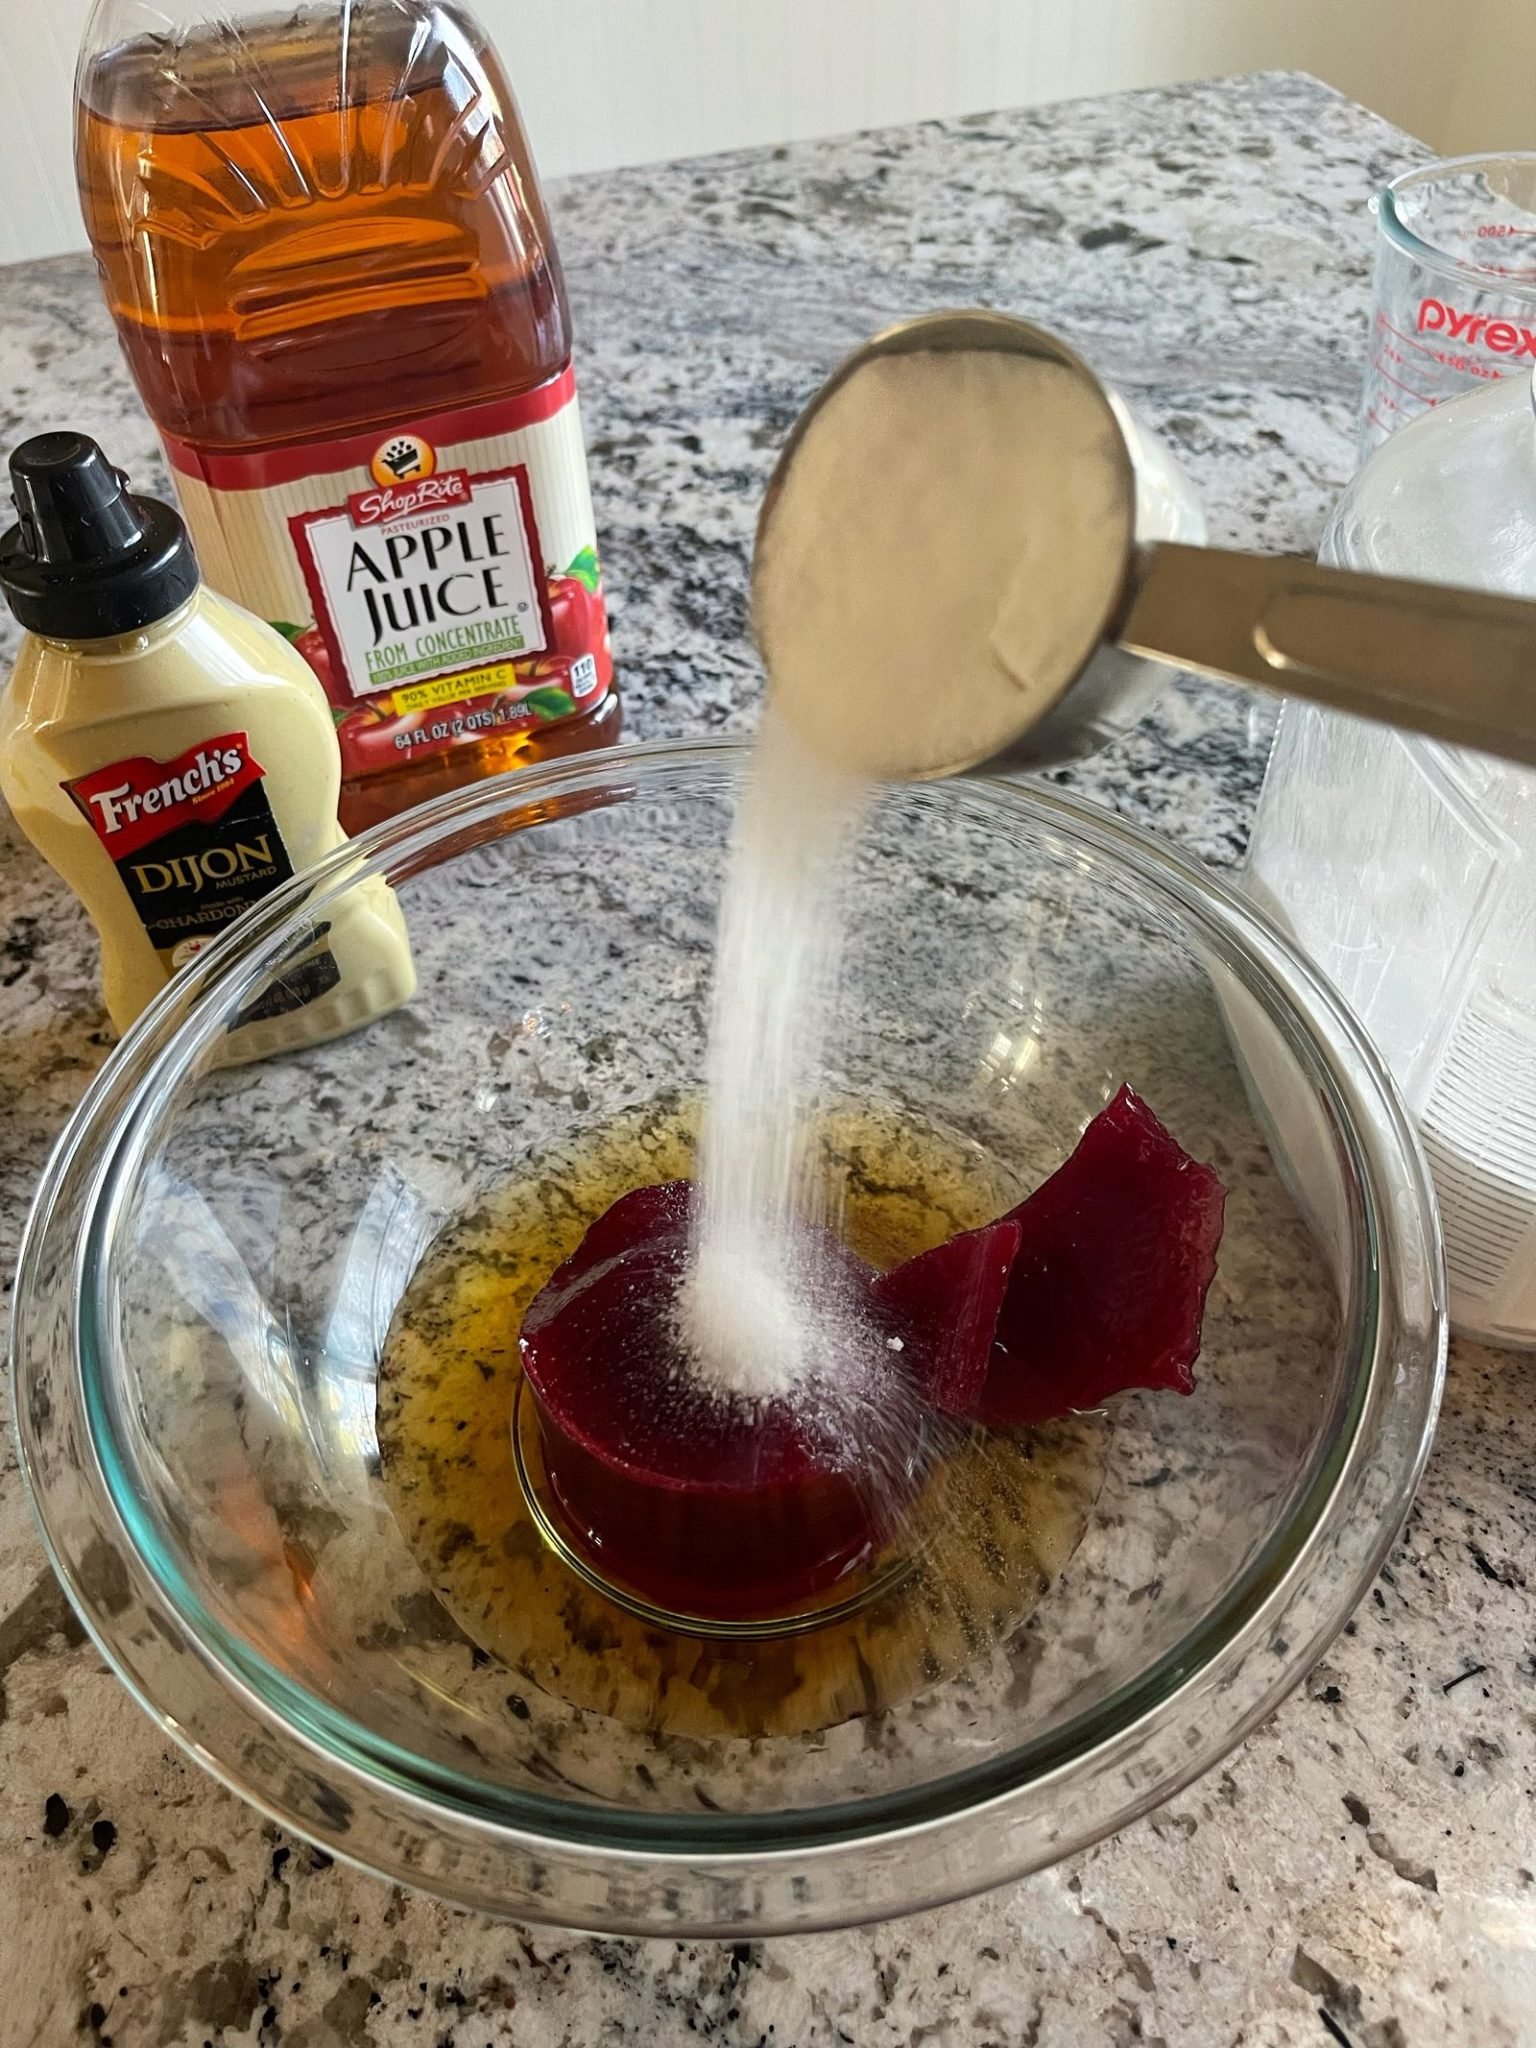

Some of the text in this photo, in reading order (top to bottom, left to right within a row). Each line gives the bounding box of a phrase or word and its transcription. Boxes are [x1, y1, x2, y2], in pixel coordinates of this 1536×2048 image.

[1416, 297, 1536, 358] pyrex
[359, 475, 463, 524] ShopRite
[380, 514, 450, 536] PASTEURIZED
[347, 514, 510, 593] APPLE
[363, 566, 509, 646] JUICE
[364, 615, 521, 671] FROM CONCENTRATE
[401, 689, 428, 703] 90%
[431, 673, 492, 695] VITAMIN
[496, 668, 506, 680] C
[395, 735, 411, 750] 64
[413, 729, 430, 745] FL
[432, 722, 450, 740] OZ
[452, 718, 465, 736] (2
[467, 709, 496, 731] QTS)
[90, 748, 242, 834] French's
[130, 833, 274, 894] DIJON
[215, 865, 278, 891] MUSTARD
